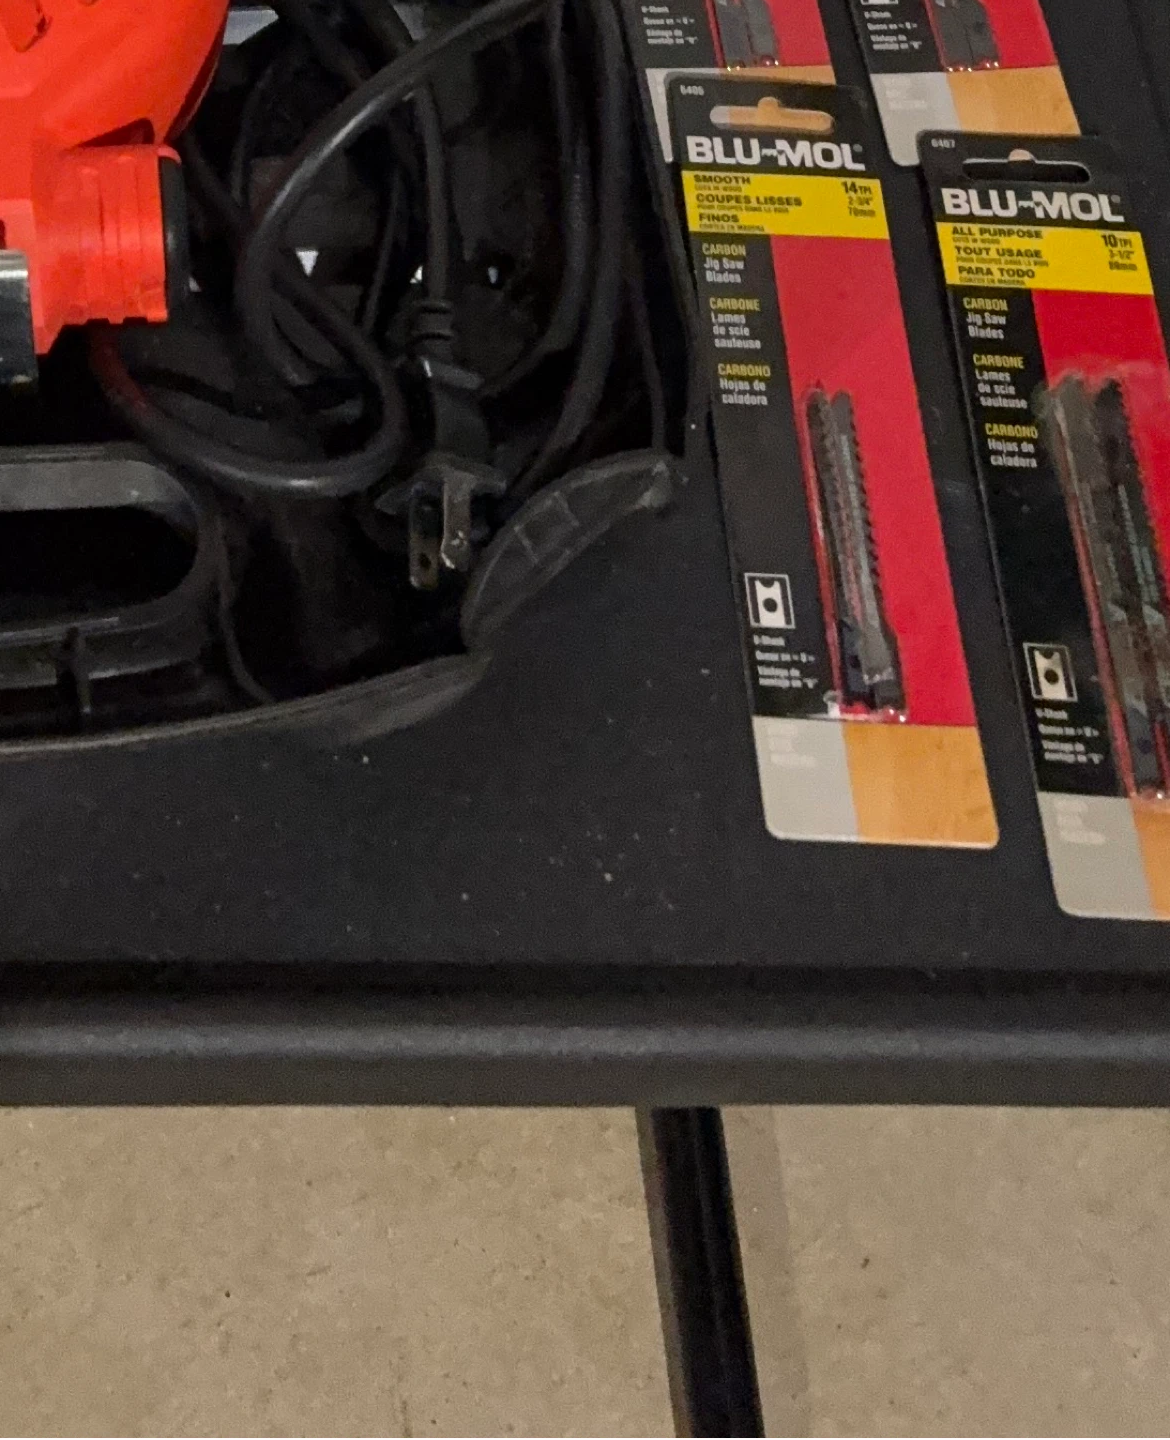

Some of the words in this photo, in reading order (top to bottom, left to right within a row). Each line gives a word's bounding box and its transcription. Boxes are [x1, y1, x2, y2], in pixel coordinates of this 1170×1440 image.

[687, 136, 865, 171] BLU-MOL
[694, 175, 750, 184] SMOOTH
[841, 181, 857, 194] 14
[858, 185, 871, 194] TPI
[696, 193, 752, 205] COUPES
[756, 196, 802, 206] LISSES
[941, 188, 1124, 223] BLU-MOL
[699, 213, 739, 222] FINOS
[952, 226, 975, 236] ALL
[980, 227, 1043, 239] PURPOSE
[1101, 234, 1117, 249] 10
[702, 243, 746, 257] CARBON
[954, 246, 991, 257] TOUT
[996, 248, 1043, 258] USAGE
[704, 257, 720, 270] Jig
[723, 257, 744, 269] Saw
[706, 271, 741, 283] Blades
[958, 266, 993, 277] PARA
[997, 268, 1035, 278] TODO
[710, 298, 761, 311] CARBONE
[963, 297, 1008, 311] CARBON
[966, 312, 982, 325] Jig
[985, 312, 1006, 325] Saw
[713, 325, 725, 335] de
[968, 325, 1004, 339] Blades
[973, 354, 1025, 369] CARBONE
[718, 364, 771, 377] CARBONO
[753, 380, 766, 391] de
[985, 423, 1038, 439] CARBONO
